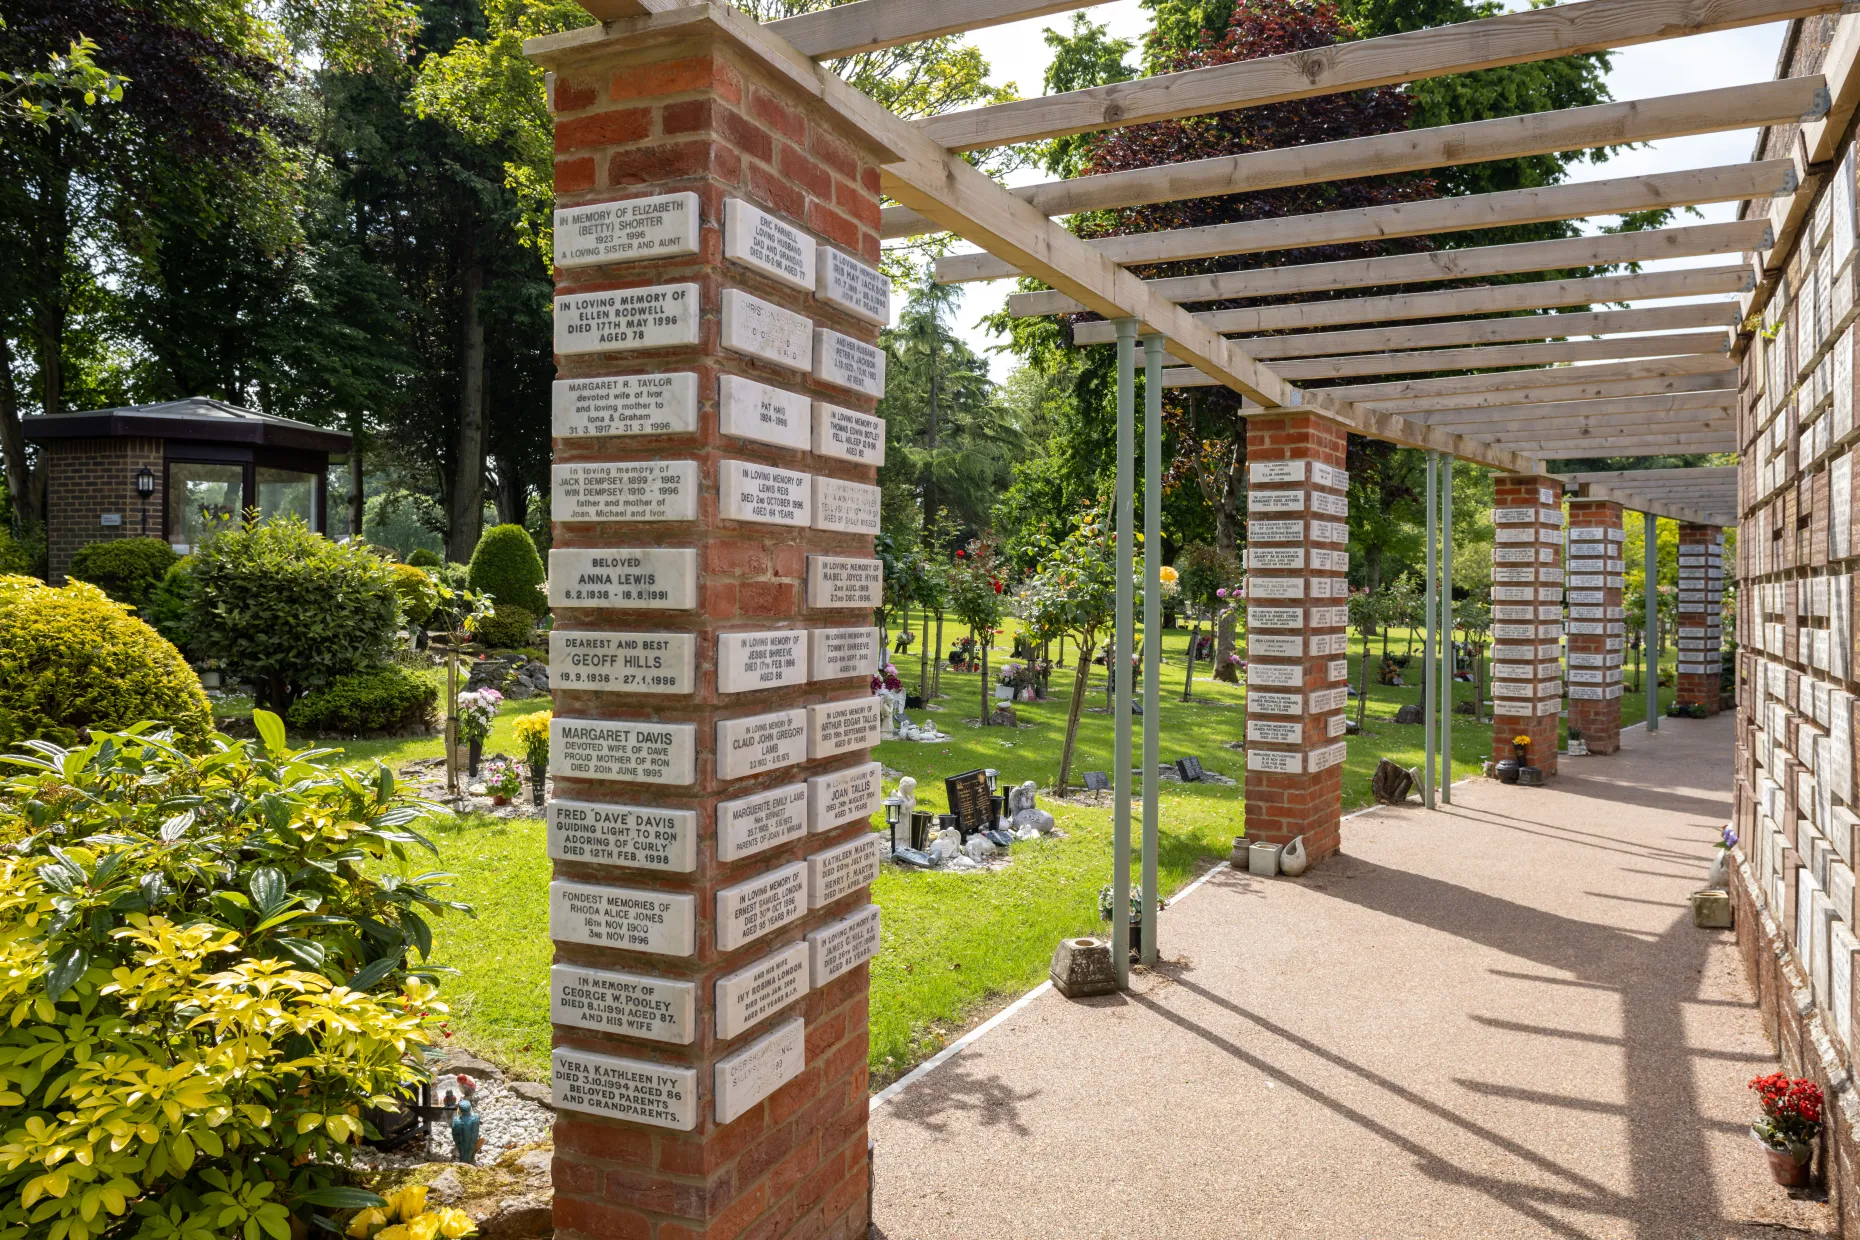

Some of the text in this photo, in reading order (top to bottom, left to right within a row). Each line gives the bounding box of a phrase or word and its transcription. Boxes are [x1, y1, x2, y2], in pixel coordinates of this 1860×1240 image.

[559, 200, 683, 226] IN MEMORY OF ELIZABETH
[578, 215, 663, 237] (BETTY) SHORTER
[760, 216, 798, 244] ERIC PARNELL
[595, 231, 646, 245] 1923 1996
[755, 226, 802, 256] LOVING HUSBAND
[561, 237, 681, 260] A LOVING SISTER AND AUNT
[753, 237, 803, 269] DAD AND GRANDAD
[750, 247, 764, 262] DIED
[784, 262, 798, 277] AGED
[579, 304, 665, 321] ELLEN RODWELL
[567, 315, 678, 334] DIED 17TH MAY 1996
[599, 331, 645, 343] AGED 78
[568, 378, 672, 392] MARGARET R. TAYLOR
[761, 402, 771, 413] PAT
[588, 413, 651, 423] Iona & Graham
[760, 413, 772, 424] 1924
[559, 475, 681, 487] JACK DEMPSEY 1899 1982
[758, 484, 789, 496] LEWIS REIS
[741, 493, 755, 504] DIED
[766, 496, 791, 508] OCTOBER
[592, 558, 641, 567] BELOVED
[578, 574, 655, 585] ANNA LEWIS
[822, 572, 879, 582] MABEL JOYCE HYNE
[565, 590, 668, 600] 6.2.1936 16.8.1991
[565, 639, 669, 650] DEAREST AND BEST
[748, 647, 793, 660] JESSIE SHREEVE
[572, 654, 662, 669] GEOFF HILLS
[560, 672, 676, 685] 19.9.1936 27.1.1996
[821, 714, 877, 732] ARTHUR EDGAR TALLIS
[562, 727, 672, 745] MARGARET DAVIS
[733, 726, 804, 750] CLAUD JOHN GREGORY
[831, 781, 870, 801] JOAN TALLIS
[732, 800, 771, 820] MARGUERITE
[772, 795, 788, 809] EMILY
[557, 808, 587, 821] FRED
[635, 814, 675, 829] DAVIS
[556, 822, 677, 841] GUIDING LIGHT TO RON
[565, 834, 610, 847] ADORING
[614, 837, 628, 849] OF
[563, 845, 669, 864] DIED 12TH FEB. 1998
[822, 840, 875, 868] KATHLEEN MARTIN
[562, 892, 671, 912] FONDEST MEMORIES OF
[734, 882, 803, 919] ERNEST SAMUEL LONDON
[570, 904, 664, 923] RHODA ALICE JONES
[605, 920, 624, 931] NOV
[627, 922, 649, 933] 1900
[606, 931, 625, 942] NOV
[628, 934, 649, 945] 1996
[737, 962, 802, 1004] IVY ROSINA LONDON
[563, 986, 671, 1012] GEORGE W. POOLEY
[561, 998, 676, 1024] DIED 8.1.1991 AGED 87.
[560, 1059, 678, 1088] VERA KATHLEEN IVY
[556, 1071, 682, 1101] DIED 3.10.1994 AGED 86
[570, 1084, 669, 1109] BELOVED PARENTS
[562, 1093, 680, 1122] AND GRANDPARENTS.
